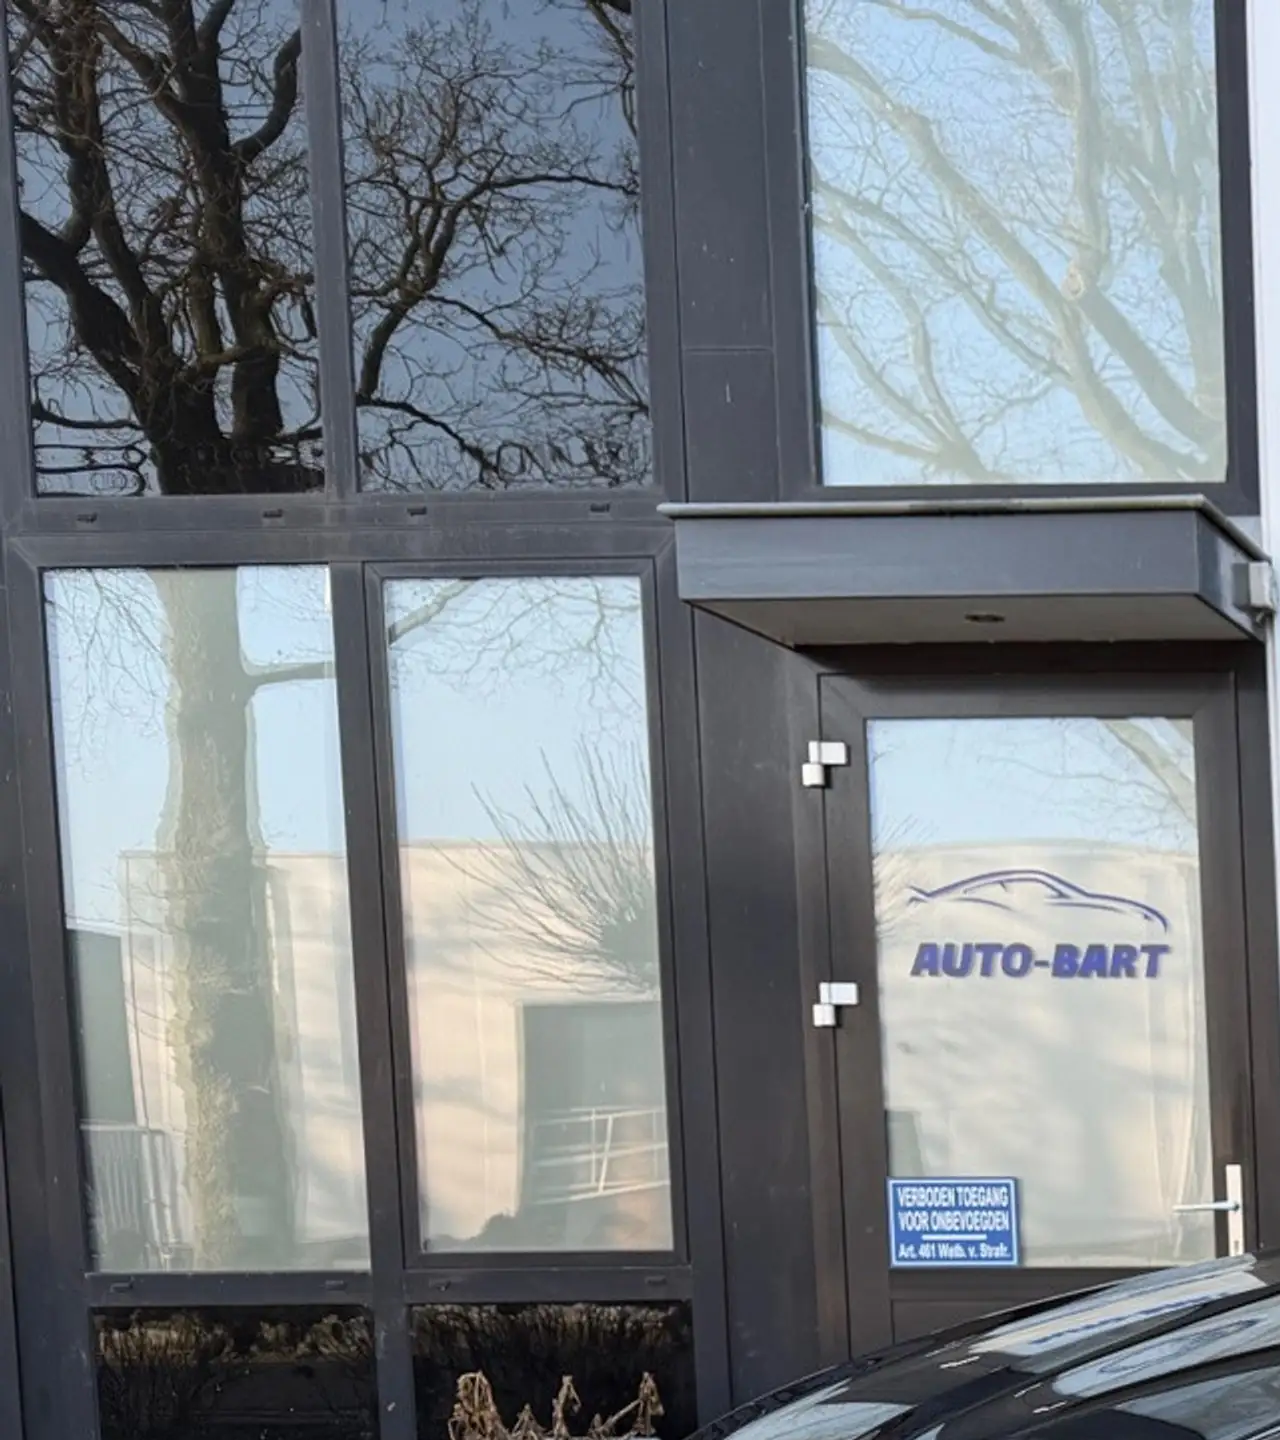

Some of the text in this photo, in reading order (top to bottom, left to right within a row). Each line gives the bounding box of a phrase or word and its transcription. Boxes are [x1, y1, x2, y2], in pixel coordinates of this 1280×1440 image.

[910, 942, 1171, 979] AUTO-BART
[897, 1186, 1009, 1207] VERBODEN TOEGANG
[898, 1210, 1010, 1231] VOOR ONBEVOEGDEN
[898, 1243, 917, 1259] Art.
[918, 1243, 937, 1259] 461
[968, 1246, 979, 1259] v.
